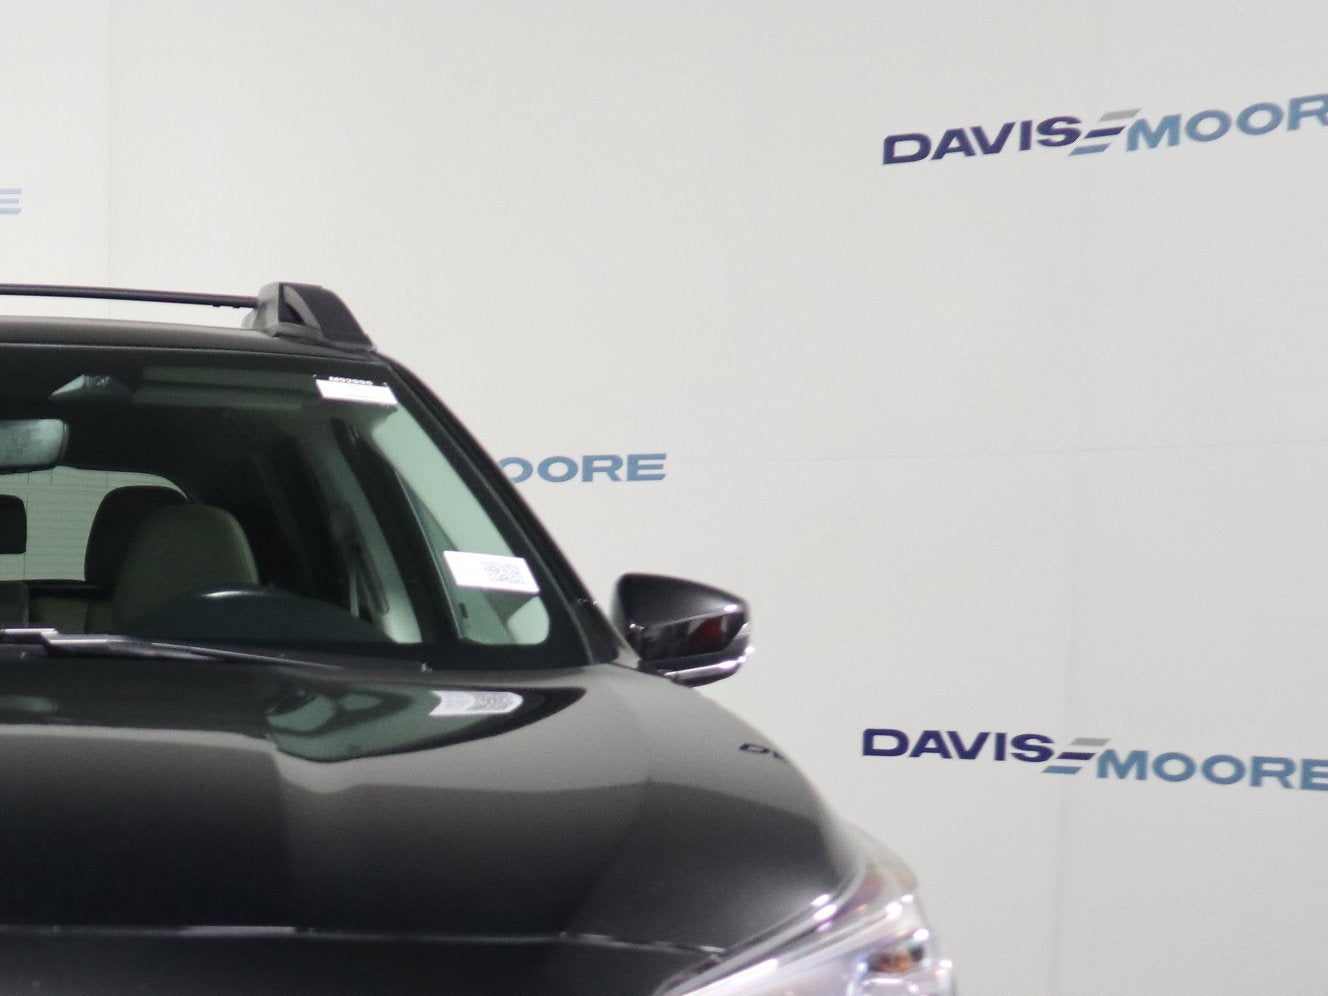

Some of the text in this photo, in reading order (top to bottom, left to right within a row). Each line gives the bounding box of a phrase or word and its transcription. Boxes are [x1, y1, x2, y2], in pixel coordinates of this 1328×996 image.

[881, 93, 1328, 167] DAVIS MOOR
[498, 453, 667, 483] OORE
[862, 728, 1328, 791] DAVIS MOORE
